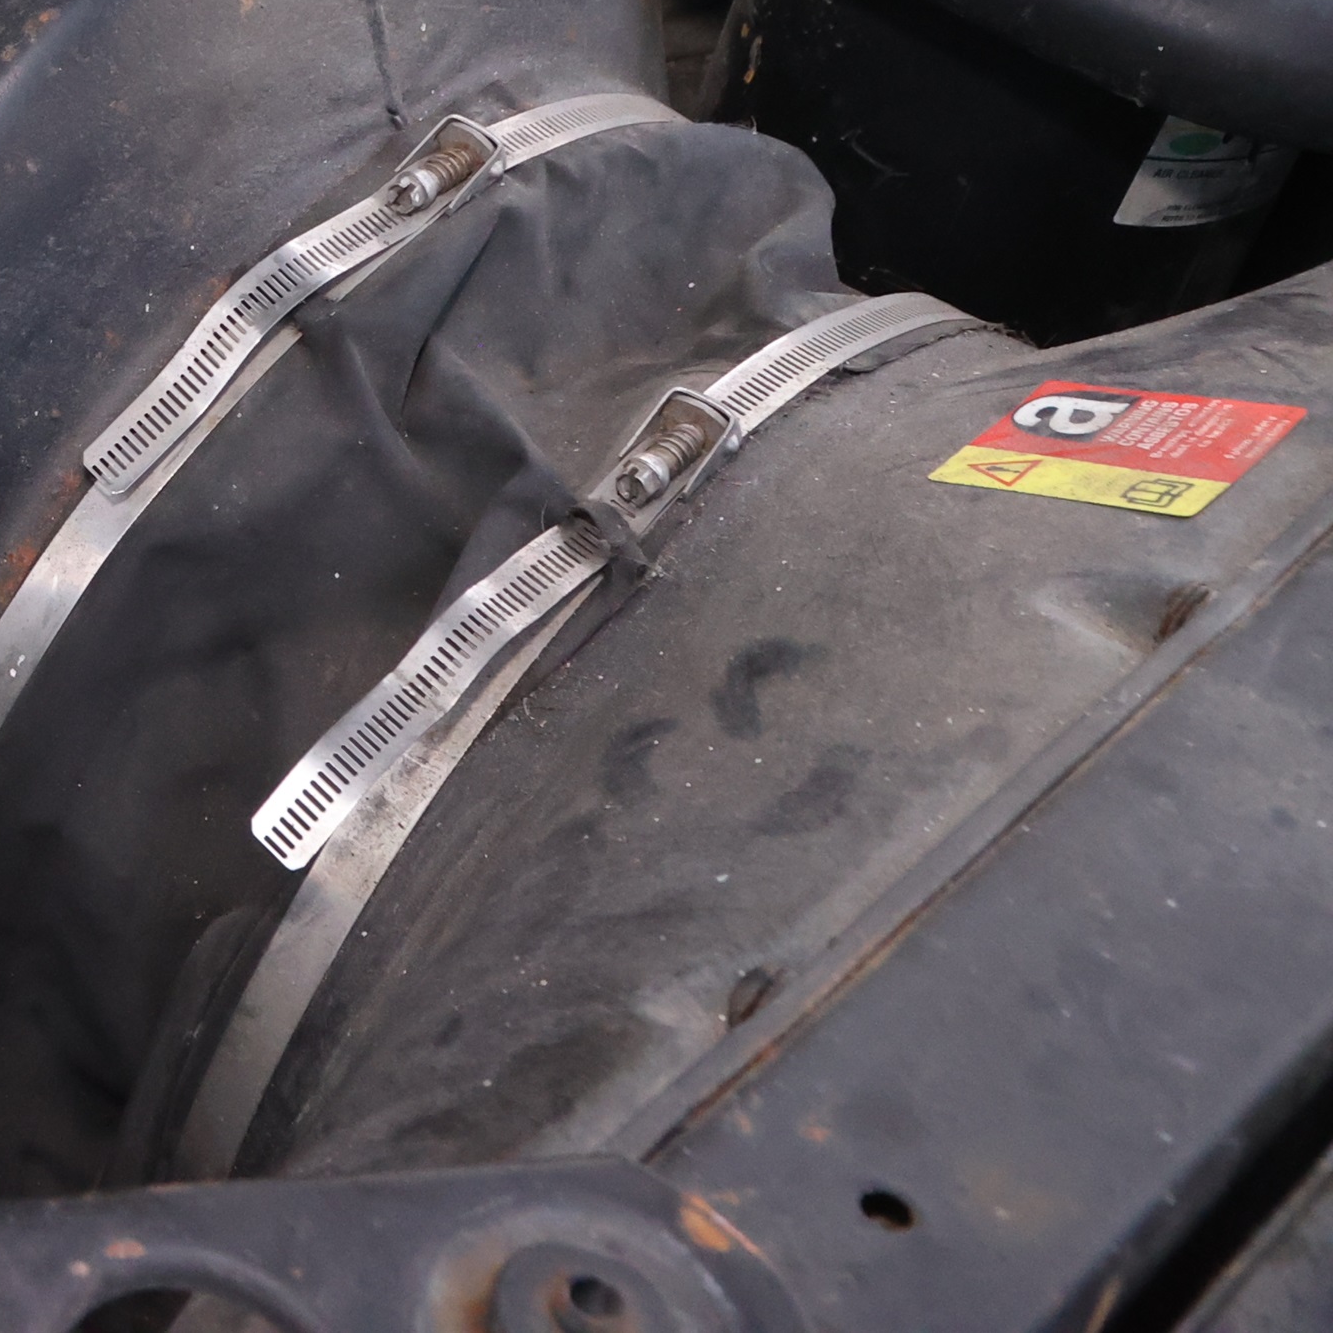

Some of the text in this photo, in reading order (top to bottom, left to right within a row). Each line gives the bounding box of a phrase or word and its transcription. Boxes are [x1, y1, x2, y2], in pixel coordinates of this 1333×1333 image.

[1013, 395, 1131, 435] a
[1099, 399, 1160, 444] WARNING
[1117, 401, 1180, 447] CONTAINS
[1136, 402, 1200, 451] ASBESTOS
